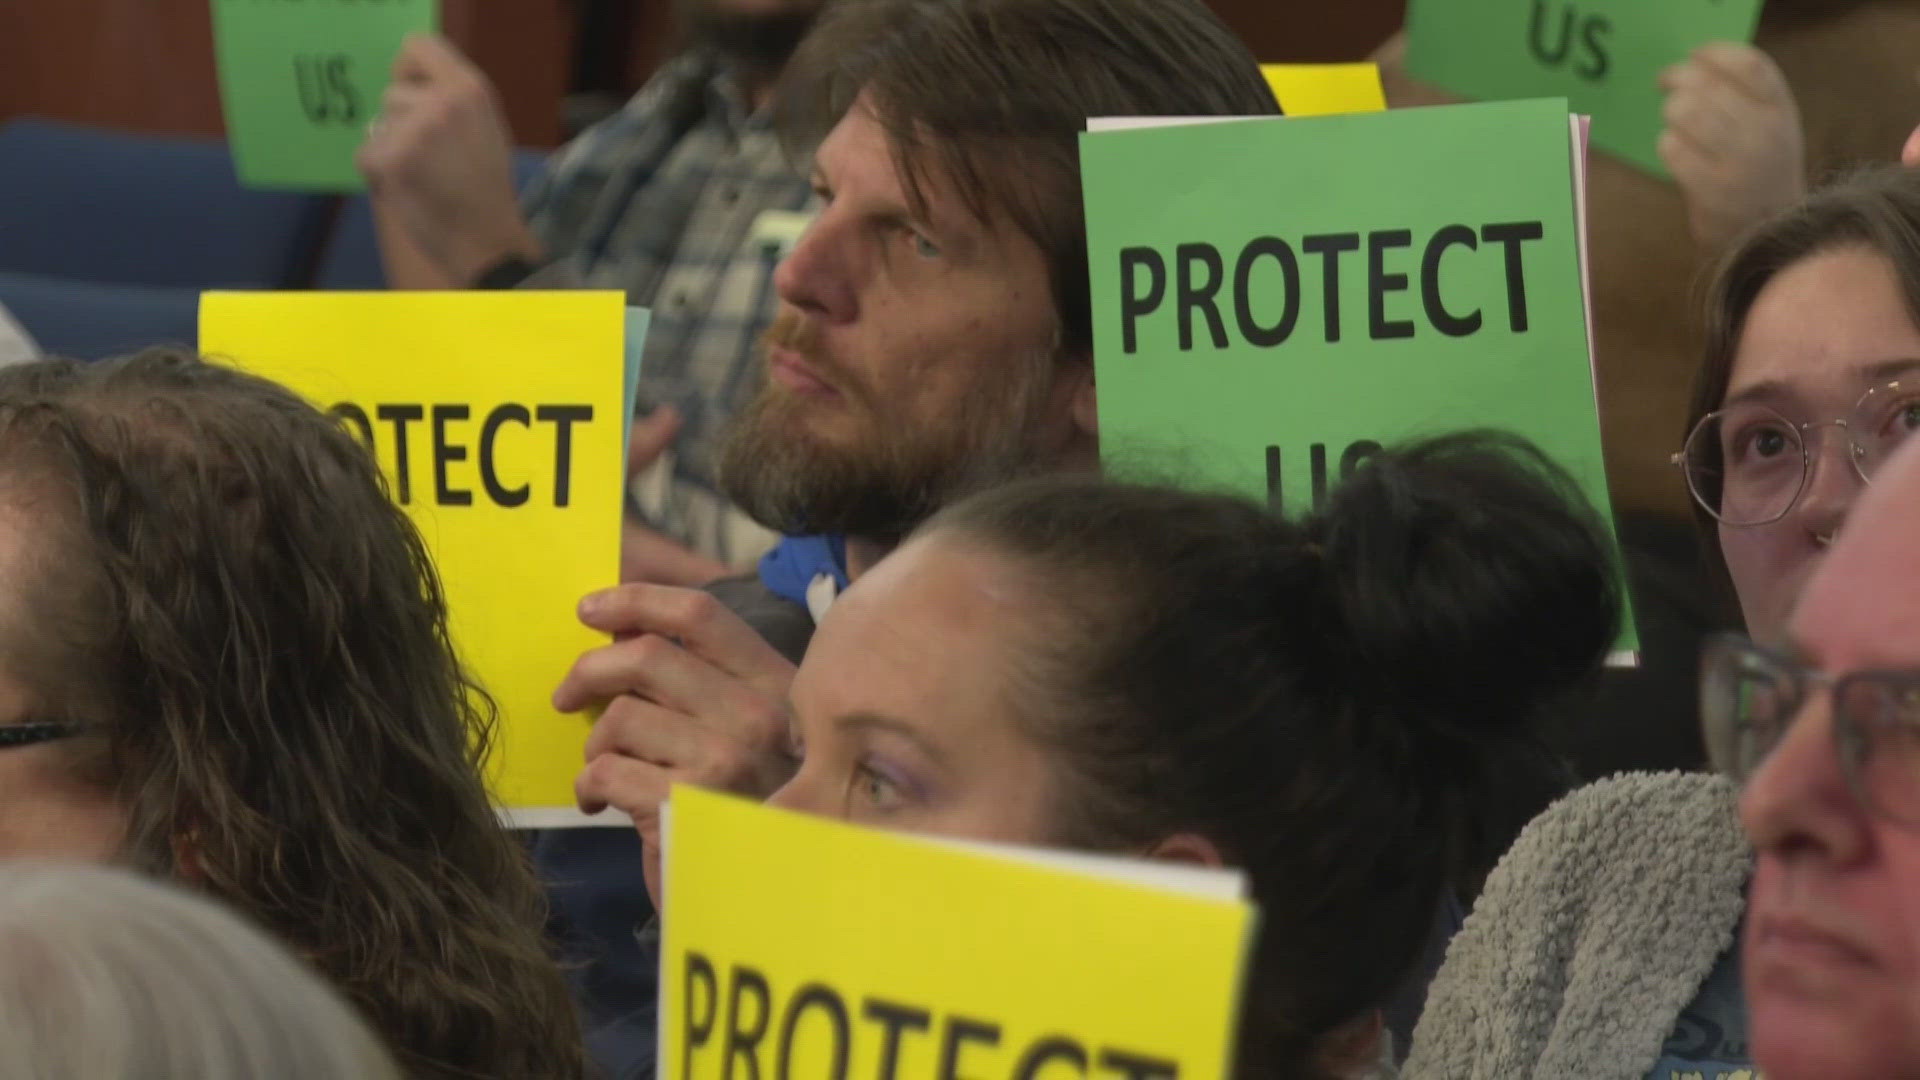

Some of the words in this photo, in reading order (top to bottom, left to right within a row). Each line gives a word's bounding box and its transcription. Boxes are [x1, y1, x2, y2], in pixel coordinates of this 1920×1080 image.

[293, 53, 363, 124] US
[1527, 0, 1614, 83] US
[1120, 221, 1543, 354] PROTECT
[326, 402, 594, 508] TECT
[683, 950, 1180, 1080] PROT
